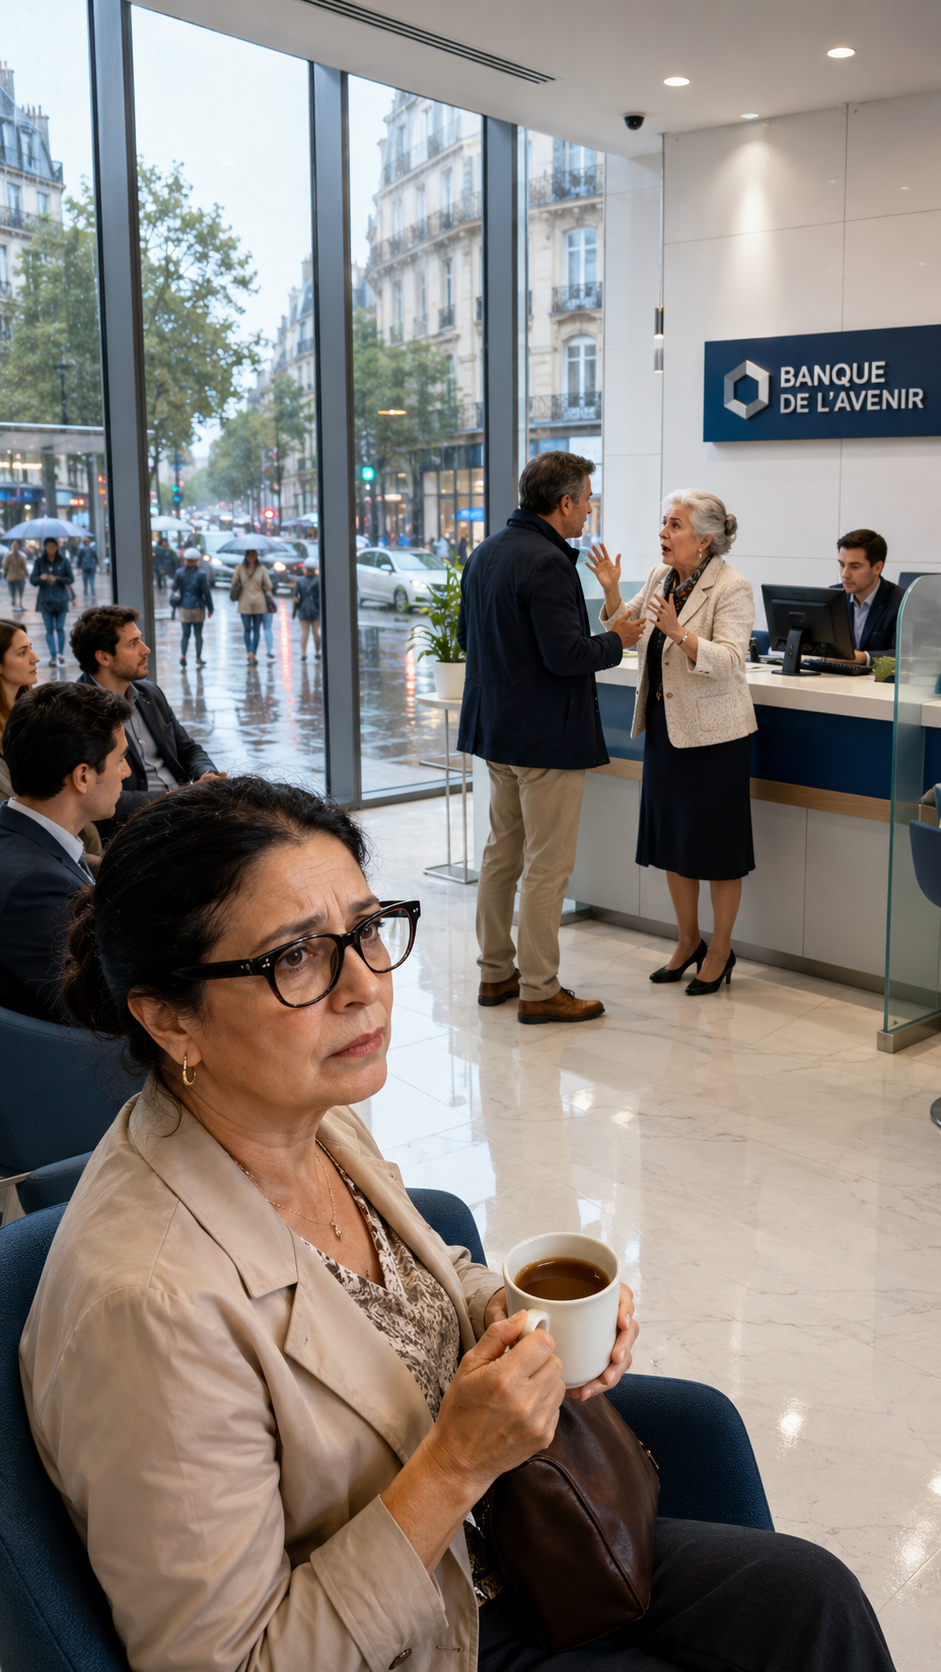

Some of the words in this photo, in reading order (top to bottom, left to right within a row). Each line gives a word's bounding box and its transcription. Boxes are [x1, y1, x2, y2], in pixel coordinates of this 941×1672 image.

[780, 361, 886, 388] BANQUE
[780, 393, 809, 413] DE
[817, 388, 924, 412] L’AVENIR
